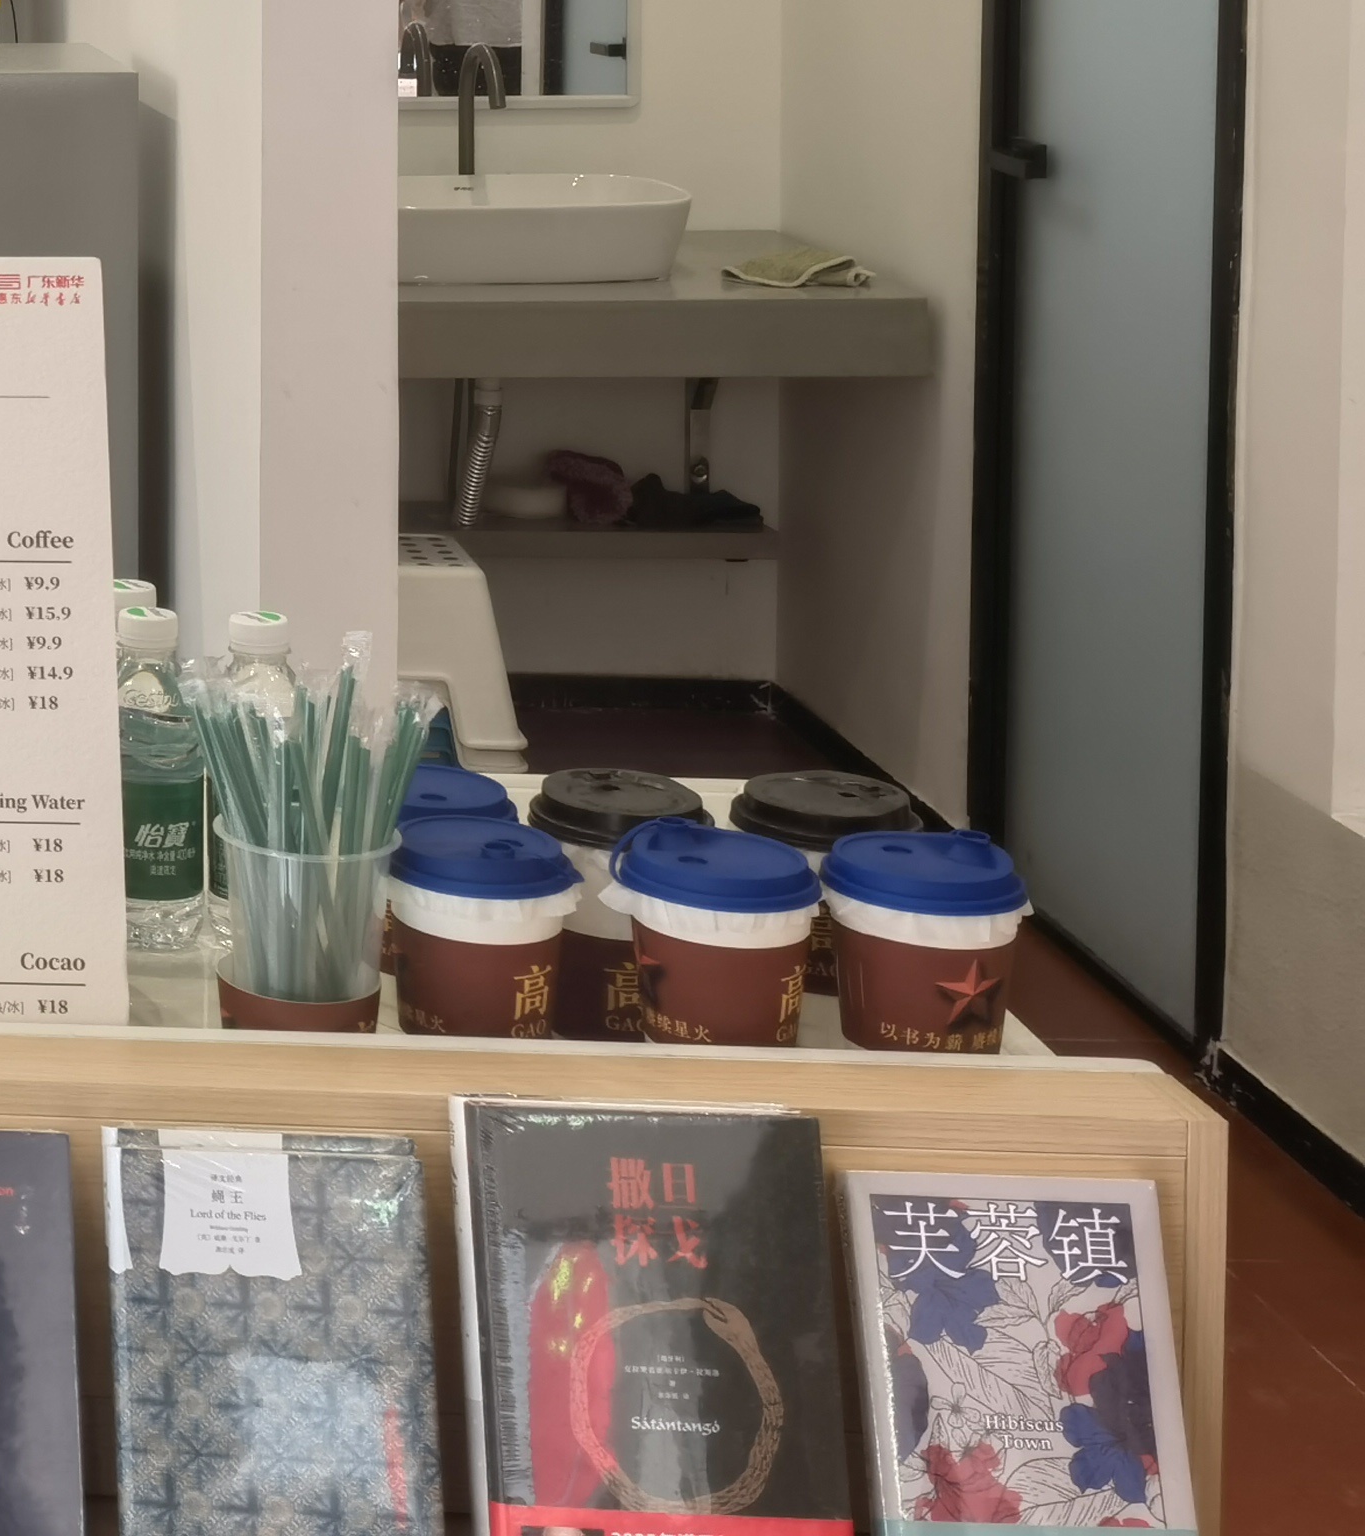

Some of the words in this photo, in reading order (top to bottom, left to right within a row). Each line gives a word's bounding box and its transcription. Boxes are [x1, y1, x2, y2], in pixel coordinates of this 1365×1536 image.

[26, 274, 85, 290] 广东新华
[7, 530, 75, 550] Coffee
[24, 575, 60, 591] ¥9.9
[25, 605, 72, 621] ¥15.9
[26, 635, 62, 650] ¥9.9
[27, 665, 74, 681] ¥14.9
[28, 695, 59, 711] ¥18
[31, 794, 85, 811] Water
[134, 821, 189, 848] 怡寶
[32, 837, 63, 853] ¥18
[34, 868, 64, 884] ¥18
[20, 951, 86, 972] Cocao
[514, 965, 552, 1020] 高
[37, 998, 68, 1014] ¥18
[607, 1156, 696, 1210] 撒旦
[211, 1190, 243, 1204] 蝇王
[190, 1209, 213, 1219] Lord
[215, 1210, 225, 1220] of
[227, 1210, 241, 1220] the
[244, 1211, 267, 1221] Flies
[612, 1213, 707, 1269] 探戈
[883, 1201, 1130, 1285] 芙蓉镇
[631, 1416, 720, 1436] Sátántangó
[985, 1415, 1064, 1432] Hibiscus
[1001, 1435, 1053, 1450] Town
